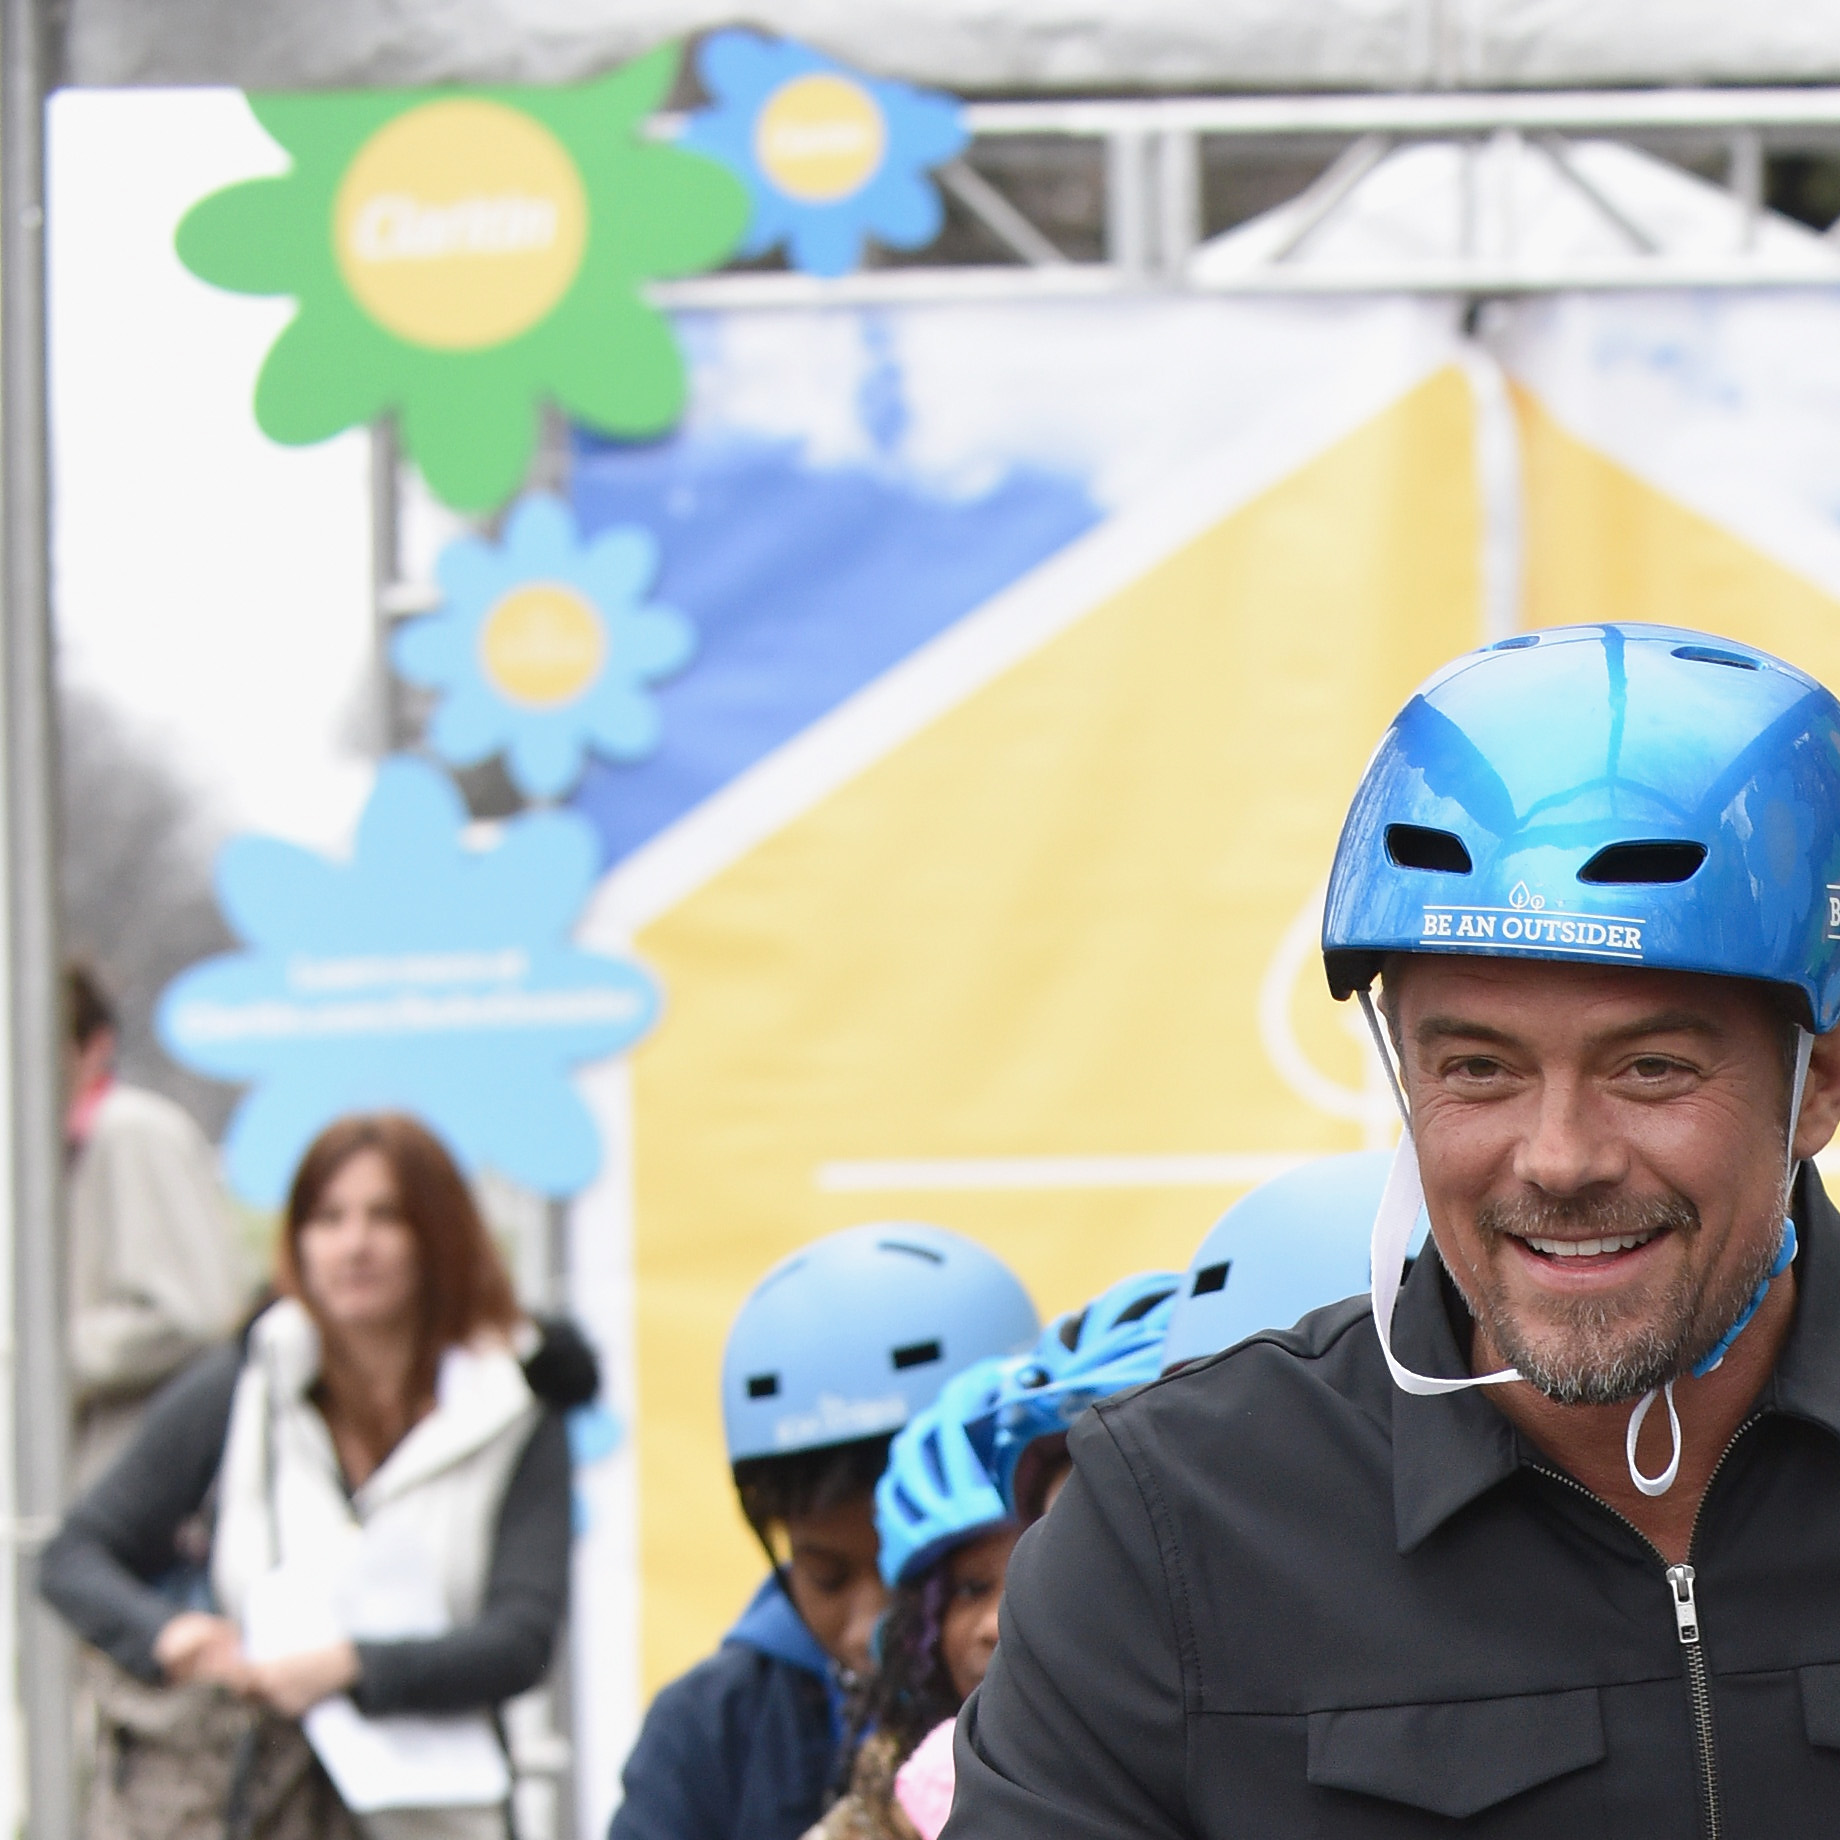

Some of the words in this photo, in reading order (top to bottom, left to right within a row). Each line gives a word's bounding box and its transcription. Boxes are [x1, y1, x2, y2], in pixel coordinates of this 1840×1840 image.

[1422, 914, 1452, 936] BE
[1456, 915, 1496, 938] AN
[1502, 917, 1643, 950] OUTSIDER
